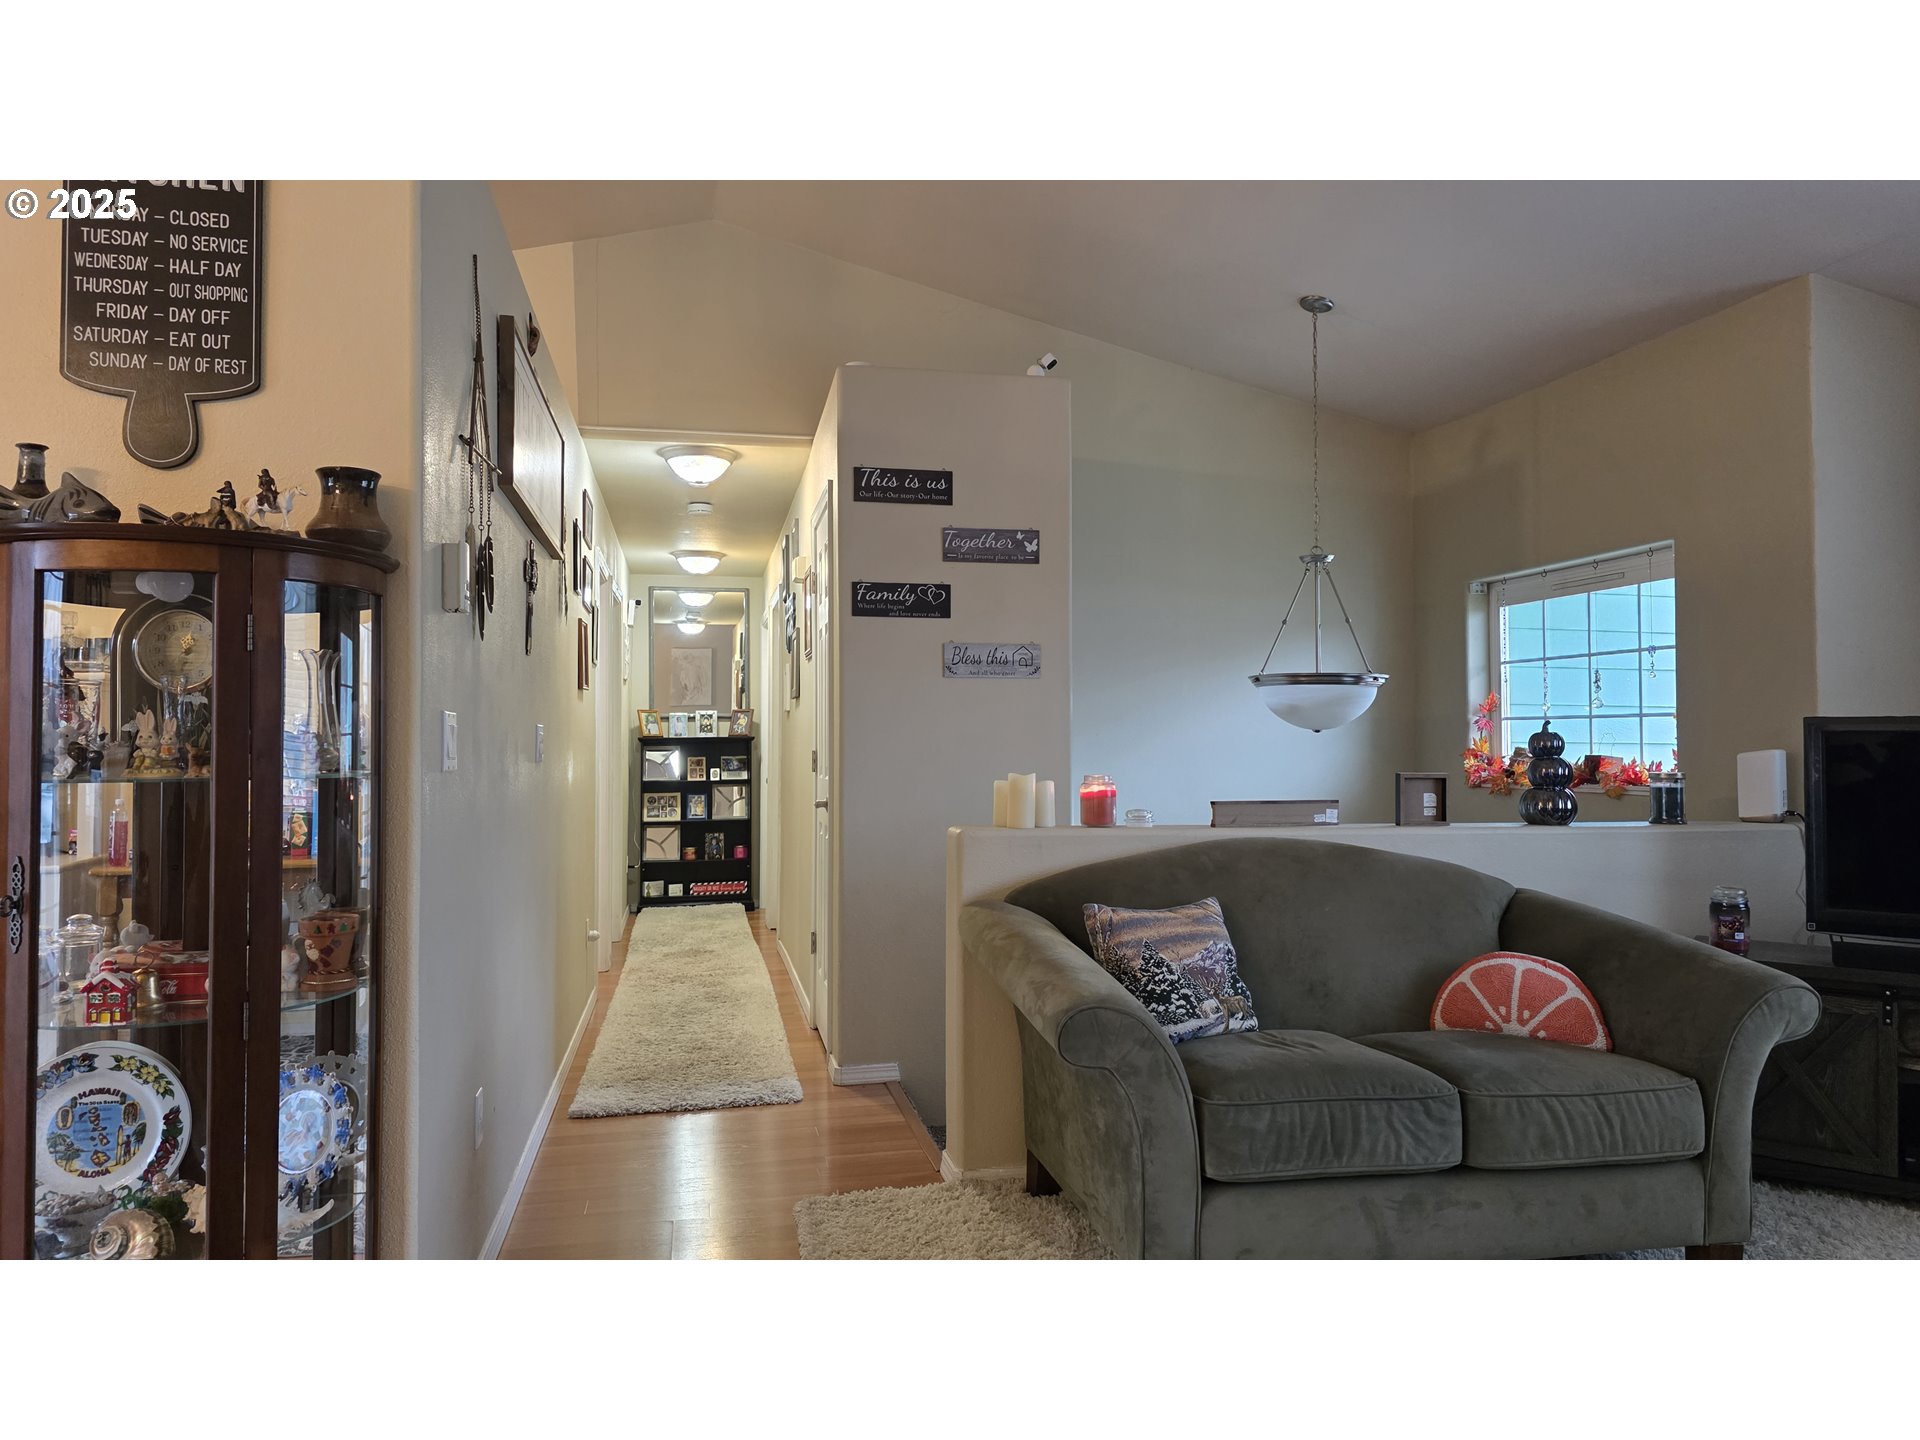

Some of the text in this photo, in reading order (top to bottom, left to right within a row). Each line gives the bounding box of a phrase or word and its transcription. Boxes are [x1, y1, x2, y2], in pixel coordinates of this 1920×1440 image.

[170, 210, 229, 228] CLOSED
[81, 228, 148, 246] TUESDAY
[170, 234, 187, 249] NO
[192, 236, 247, 254] SERVICE
[75, 252, 148, 270] WEDNESDAY
[170, 259, 209, 275] HALF
[215, 262, 241, 277] DAY
[74, 276, 148, 295] THURSDAY
[170, 283, 190, 298] OUT
[195, 285, 247, 302] SHOPPING
[97, 303, 147, 320] FRIDAY
[170, 308, 196, 323] DAY
[202, 310, 230, 324] OFF
[74, 326, 148, 344] SATURDAY
[170, 332, 196, 347] EAT
[202, 334, 230, 349] OUT
[90, 351, 147, 368] SUNDAY
[169, 356, 190, 371] DAY
[195, 358, 210, 372] OF
[215, 359, 246, 374] REST
[861, 468, 949, 490] This is us
[887, 491, 899, 499] Our
[900, 492, 915, 501] story
[918, 492, 930, 500] Our
[944, 530, 1016, 553] Together
[857, 583, 917, 606] Family
[951, 646, 1008, 666] Bless this
[78, 1088, 121, 1100] HAWAII
[77, 1168, 112, 1178] ALOHA
